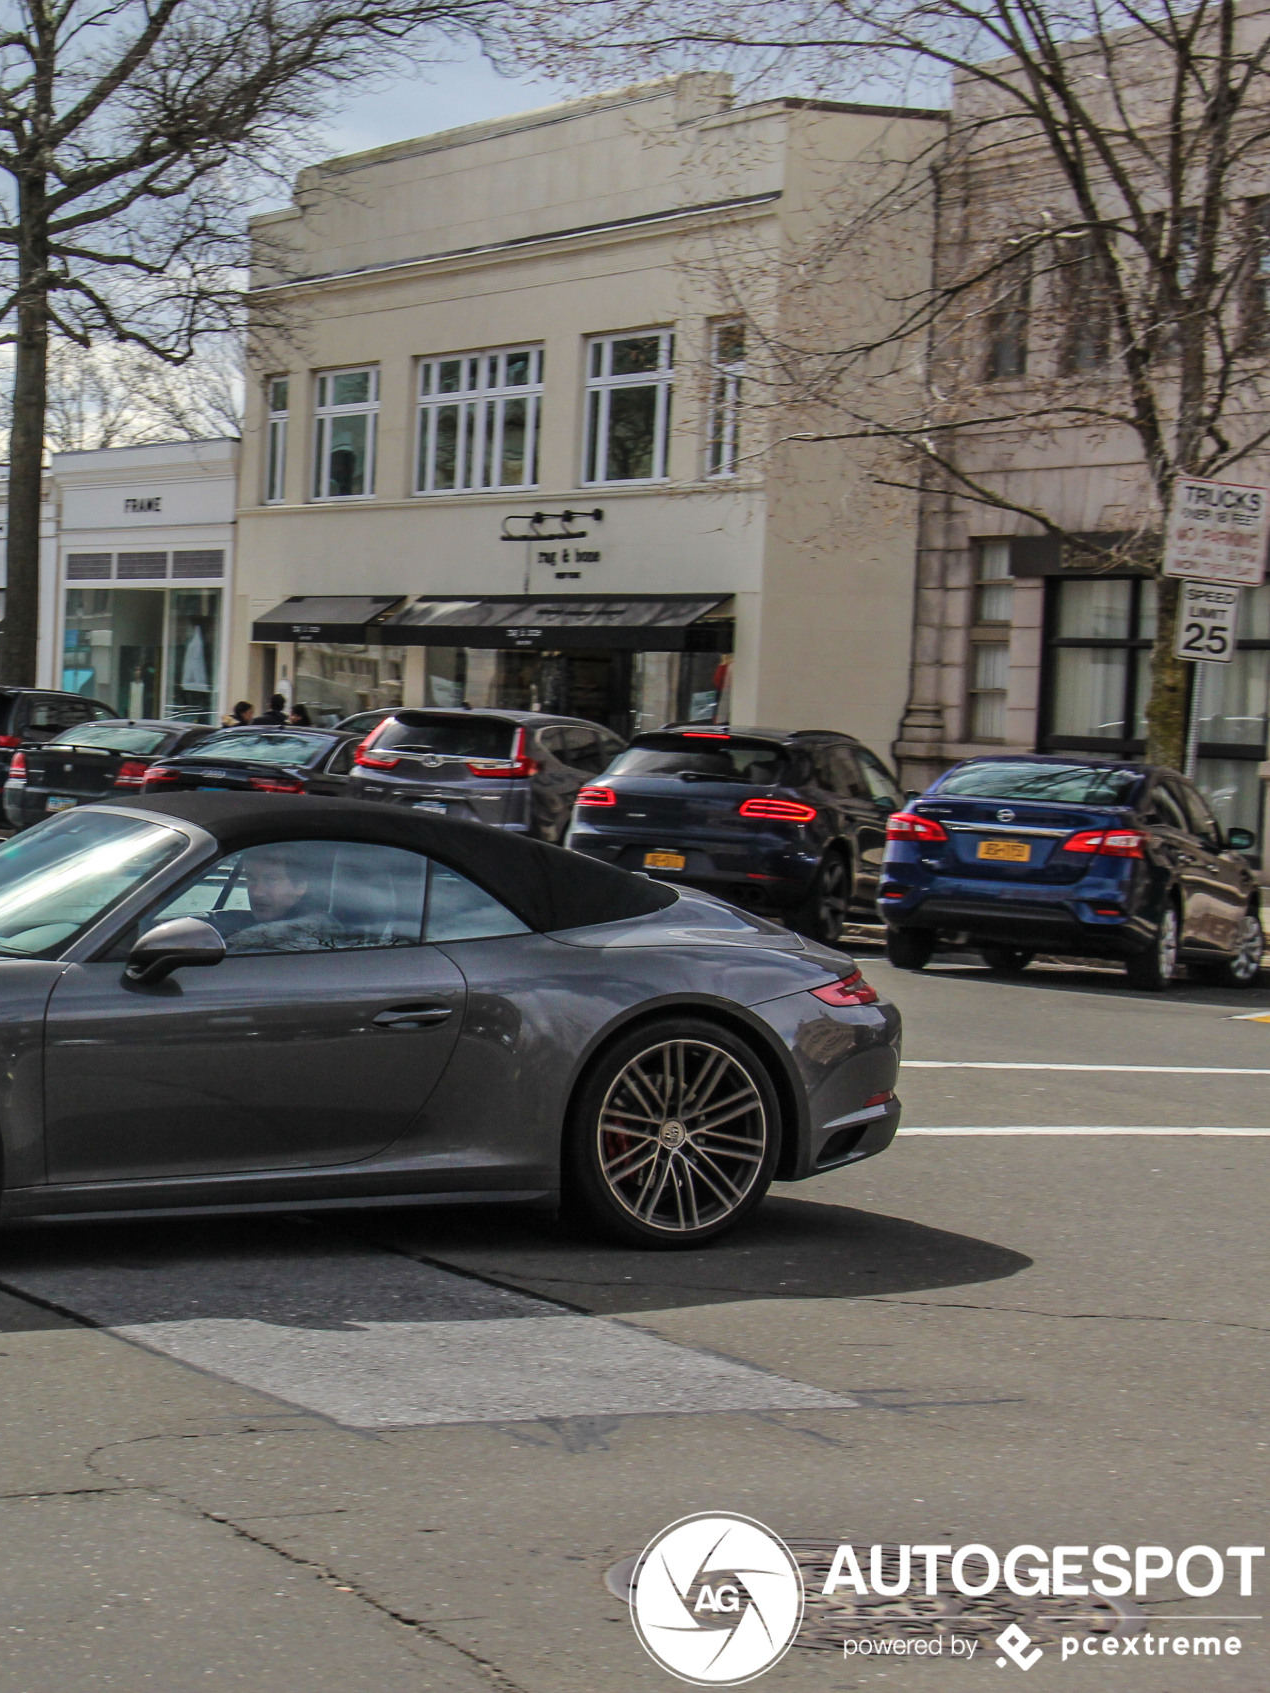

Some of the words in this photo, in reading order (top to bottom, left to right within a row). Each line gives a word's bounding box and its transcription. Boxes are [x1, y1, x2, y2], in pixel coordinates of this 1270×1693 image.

[124, 497, 161, 513] FRAME
[1185, 486, 1261, 512] TRUCKS
[1232, 513, 1260, 527] FEET
[1176, 527, 1196, 542] NO
[1186, 588, 1236, 605] SPEED
[1189, 606, 1228, 620] LIMIT
[1183, 622, 1228, 655] 25
